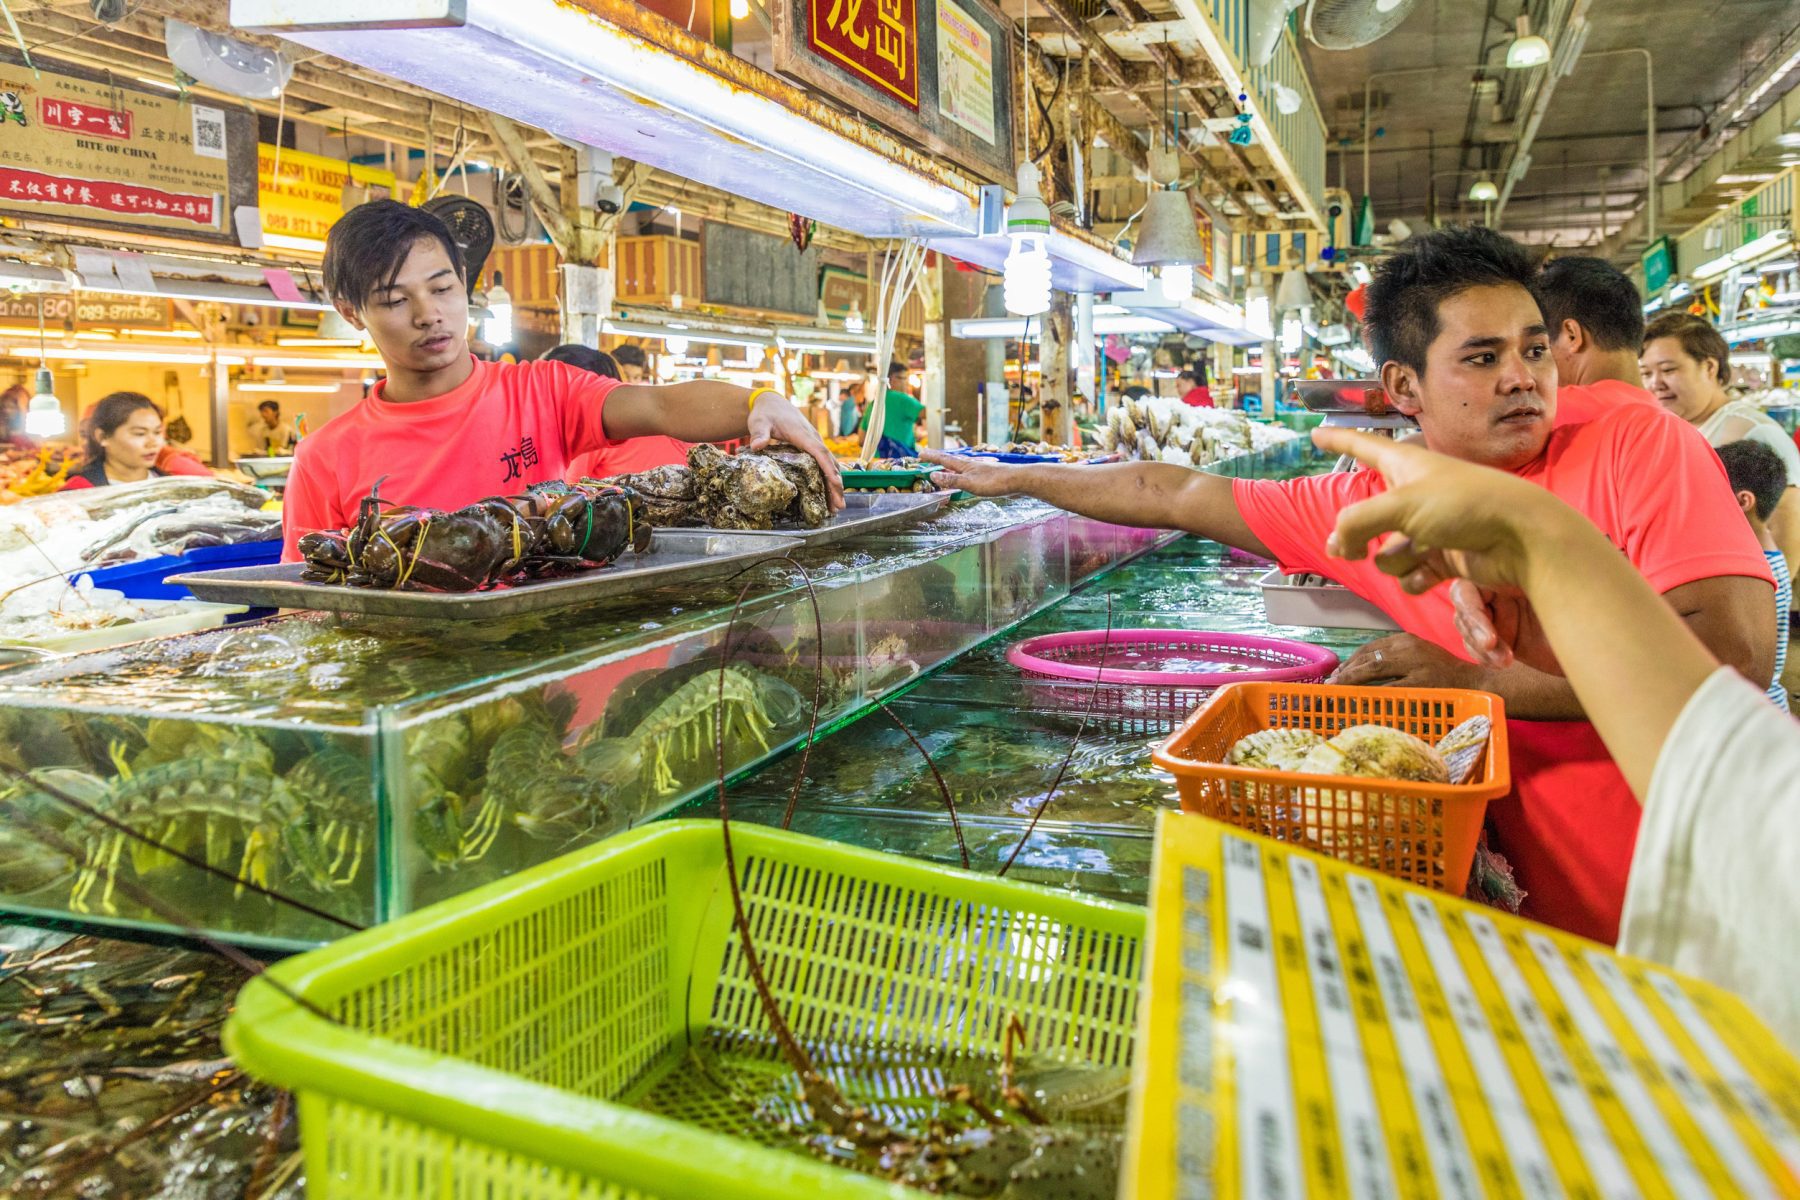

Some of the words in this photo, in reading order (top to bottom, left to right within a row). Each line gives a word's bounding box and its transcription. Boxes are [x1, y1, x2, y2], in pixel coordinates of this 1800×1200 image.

[76, 138, 104, 151] BITE
[105, 143, 121, 155] OF
[122, 146, 158, 161] CHINA
